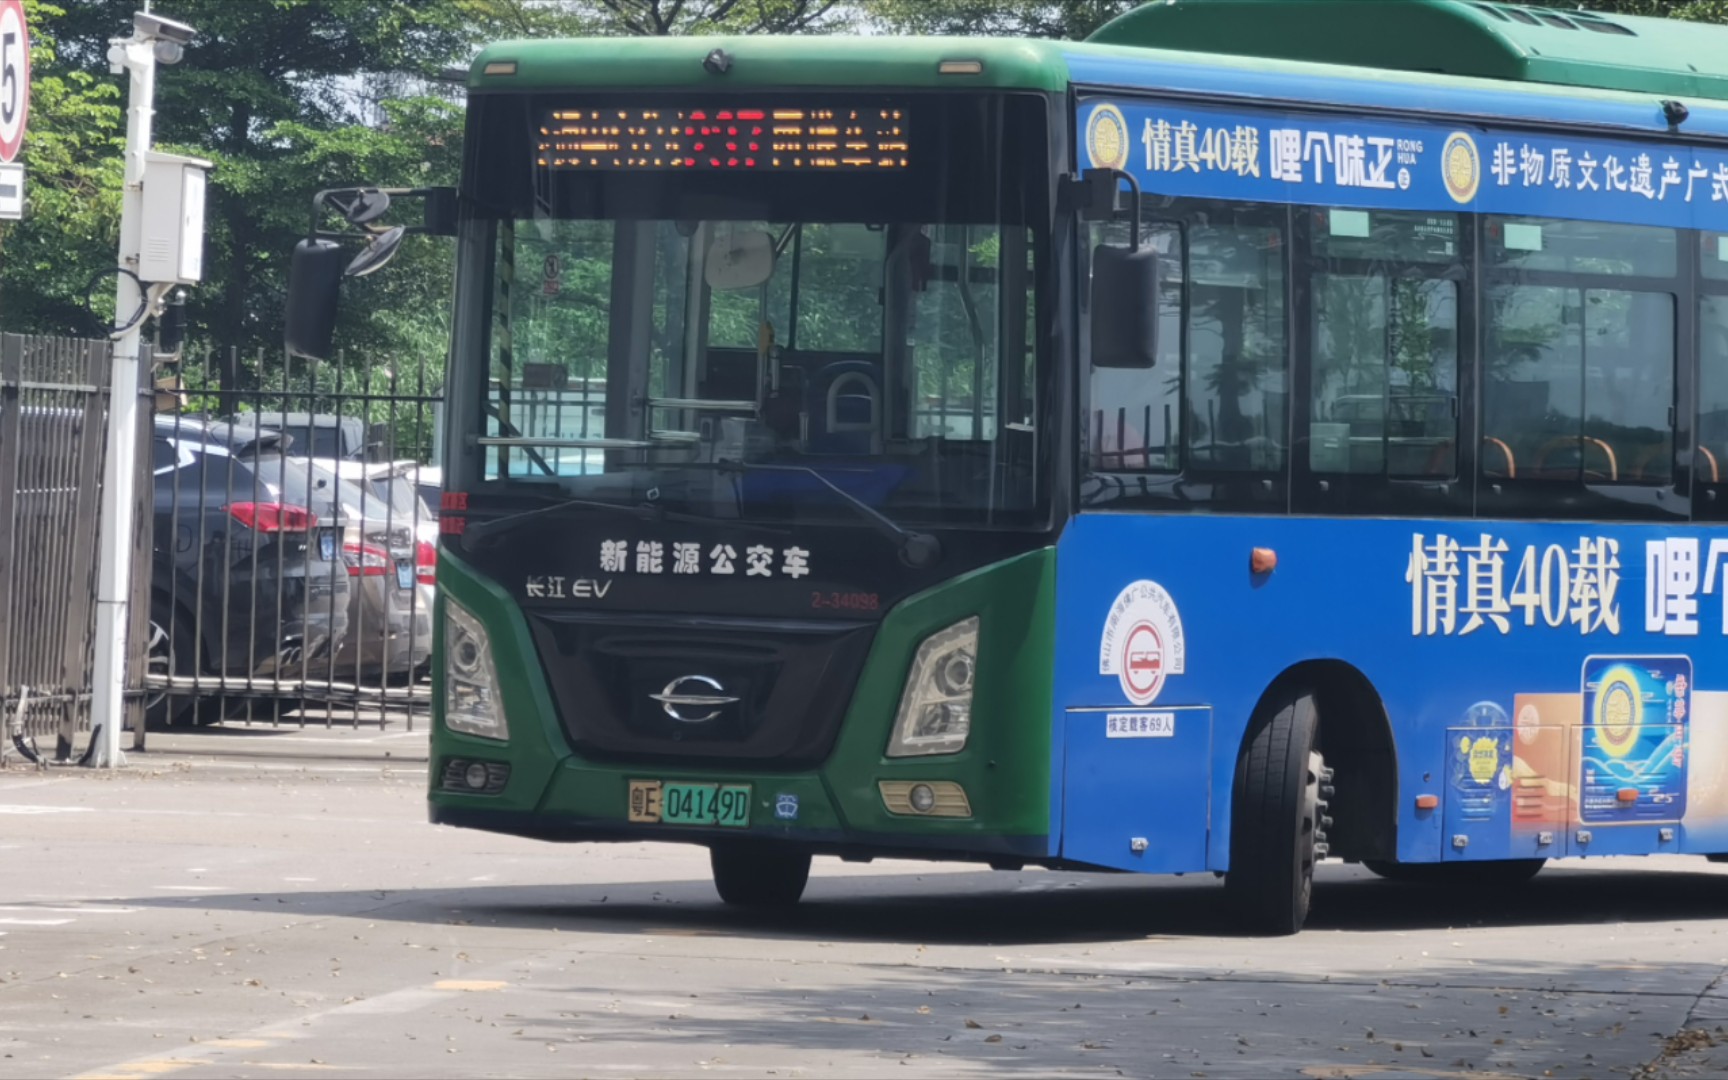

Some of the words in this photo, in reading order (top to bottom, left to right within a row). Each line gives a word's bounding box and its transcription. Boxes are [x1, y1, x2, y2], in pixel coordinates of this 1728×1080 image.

[2, 32, 17, 125] 5
[1142, 117, 1260, 178] 情真40载
[1397, 139, 1424, 153] RONG
[1397, 153, 1417, 165] HUA
[1491, 141, 1728, 202] 非物质文化遗产广式
[600, 540, 810, 578] 新能源公交车
[526, 575, 566, 598] 长江
[572, 578, 613, 598] EV
[1405, 532, 1620, 636] 情真40载
[667, 787, 748, 821] 04149D
